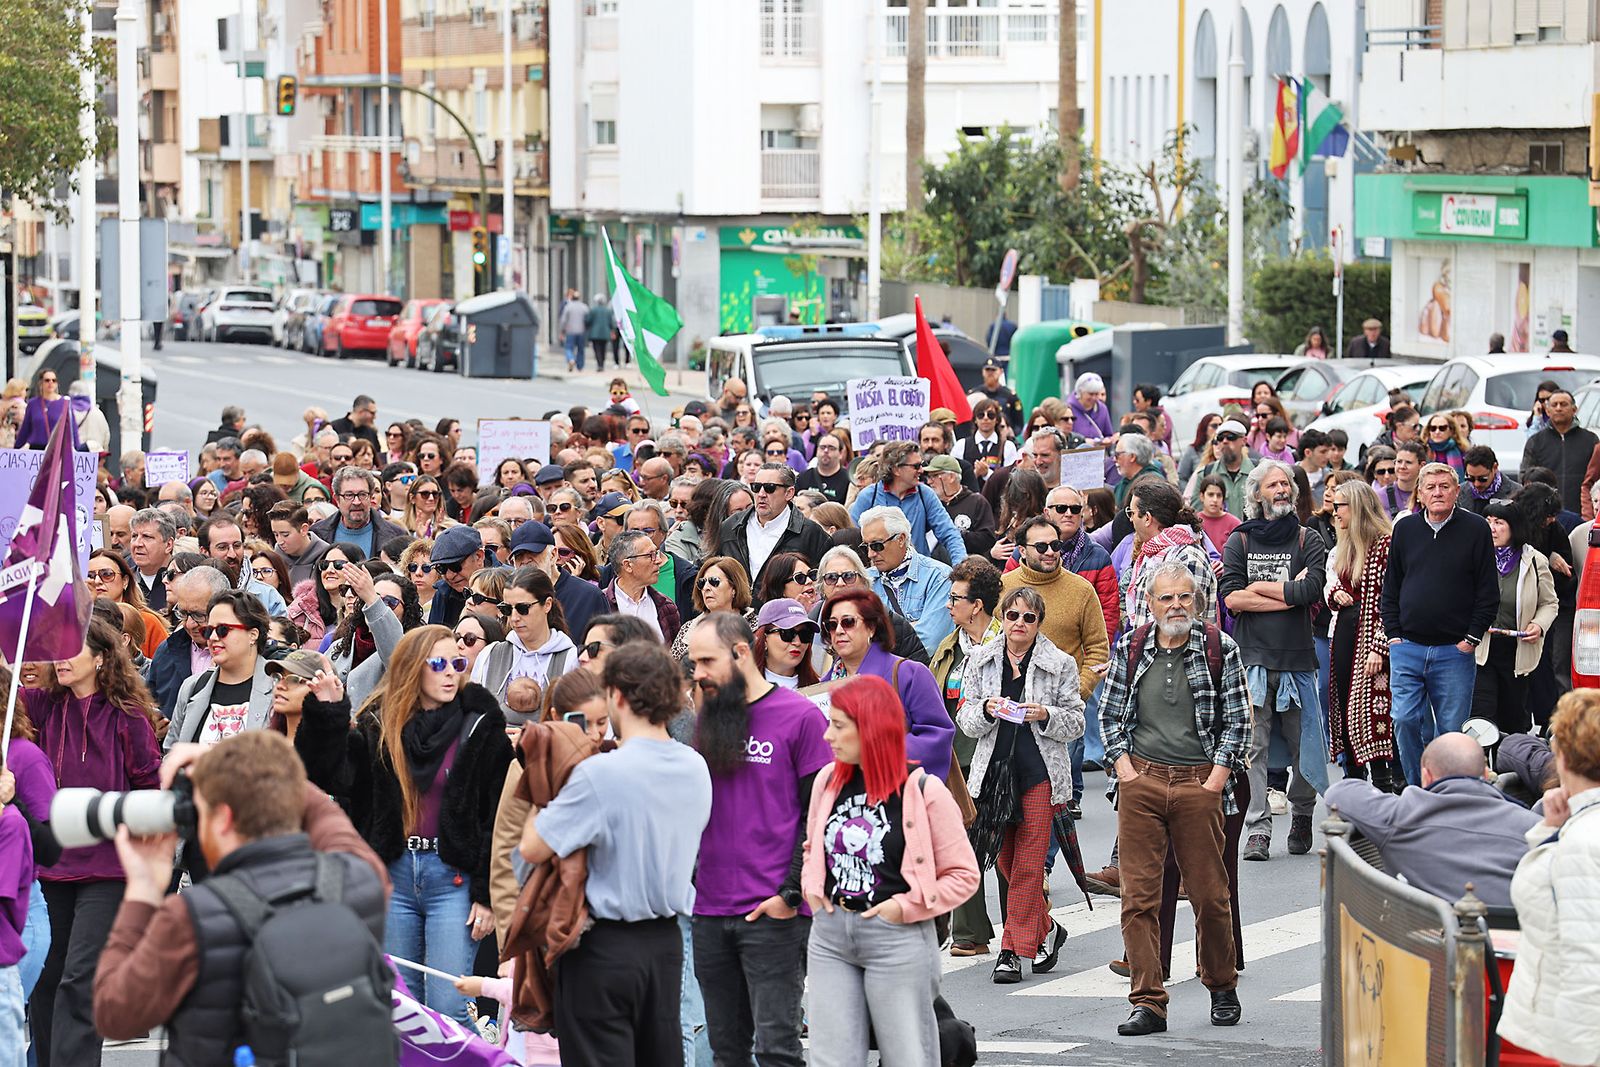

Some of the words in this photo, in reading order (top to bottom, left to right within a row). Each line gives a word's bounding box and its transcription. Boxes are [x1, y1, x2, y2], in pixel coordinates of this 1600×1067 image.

[856, 390, 884, 410] HASTA
[888, 388, 899, 406] EL
[900, 388, 926, 408] COÑO
